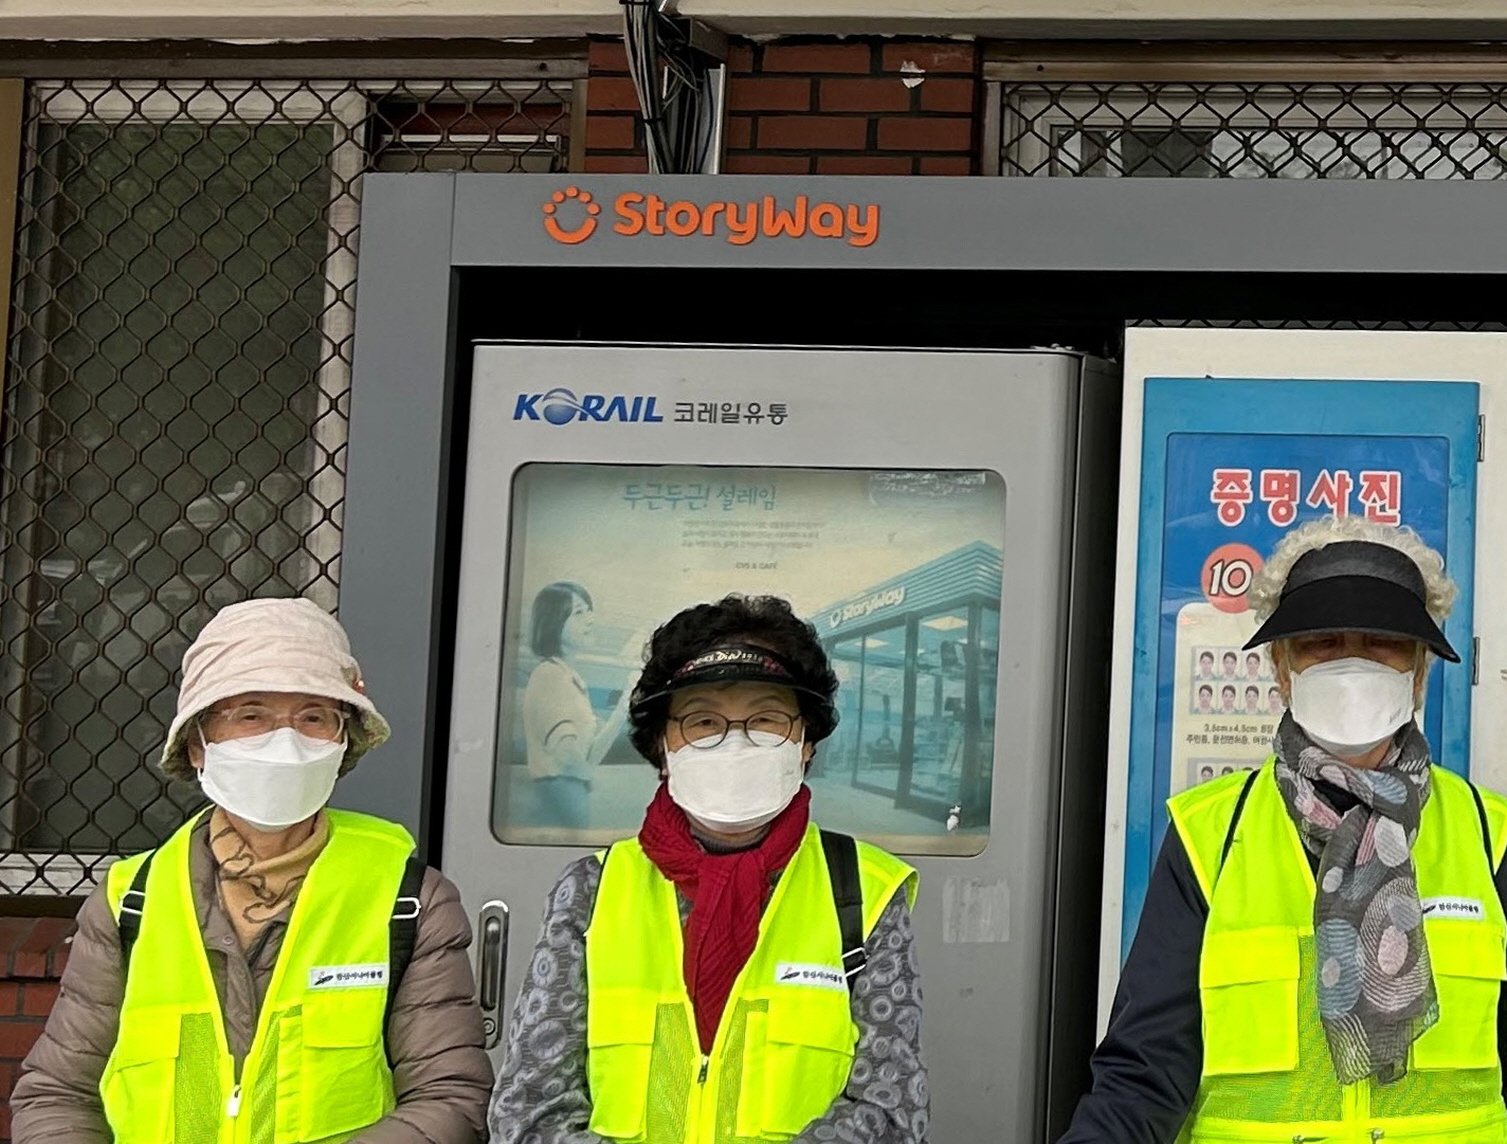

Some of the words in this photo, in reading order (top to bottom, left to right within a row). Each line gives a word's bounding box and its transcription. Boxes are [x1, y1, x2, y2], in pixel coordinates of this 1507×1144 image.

[613, 192, 880, 247] StoryWay
[511, 386, 664, 425] KORAIL
[674, 402, 789, 425] 코레일유통
[624, 484, 710, 512] 두근두근!
[716, 485, 777, 511] 설레임
[1211, 468, 1402, 527] 증명사진
[1209, 558, 1254, 598] 10
